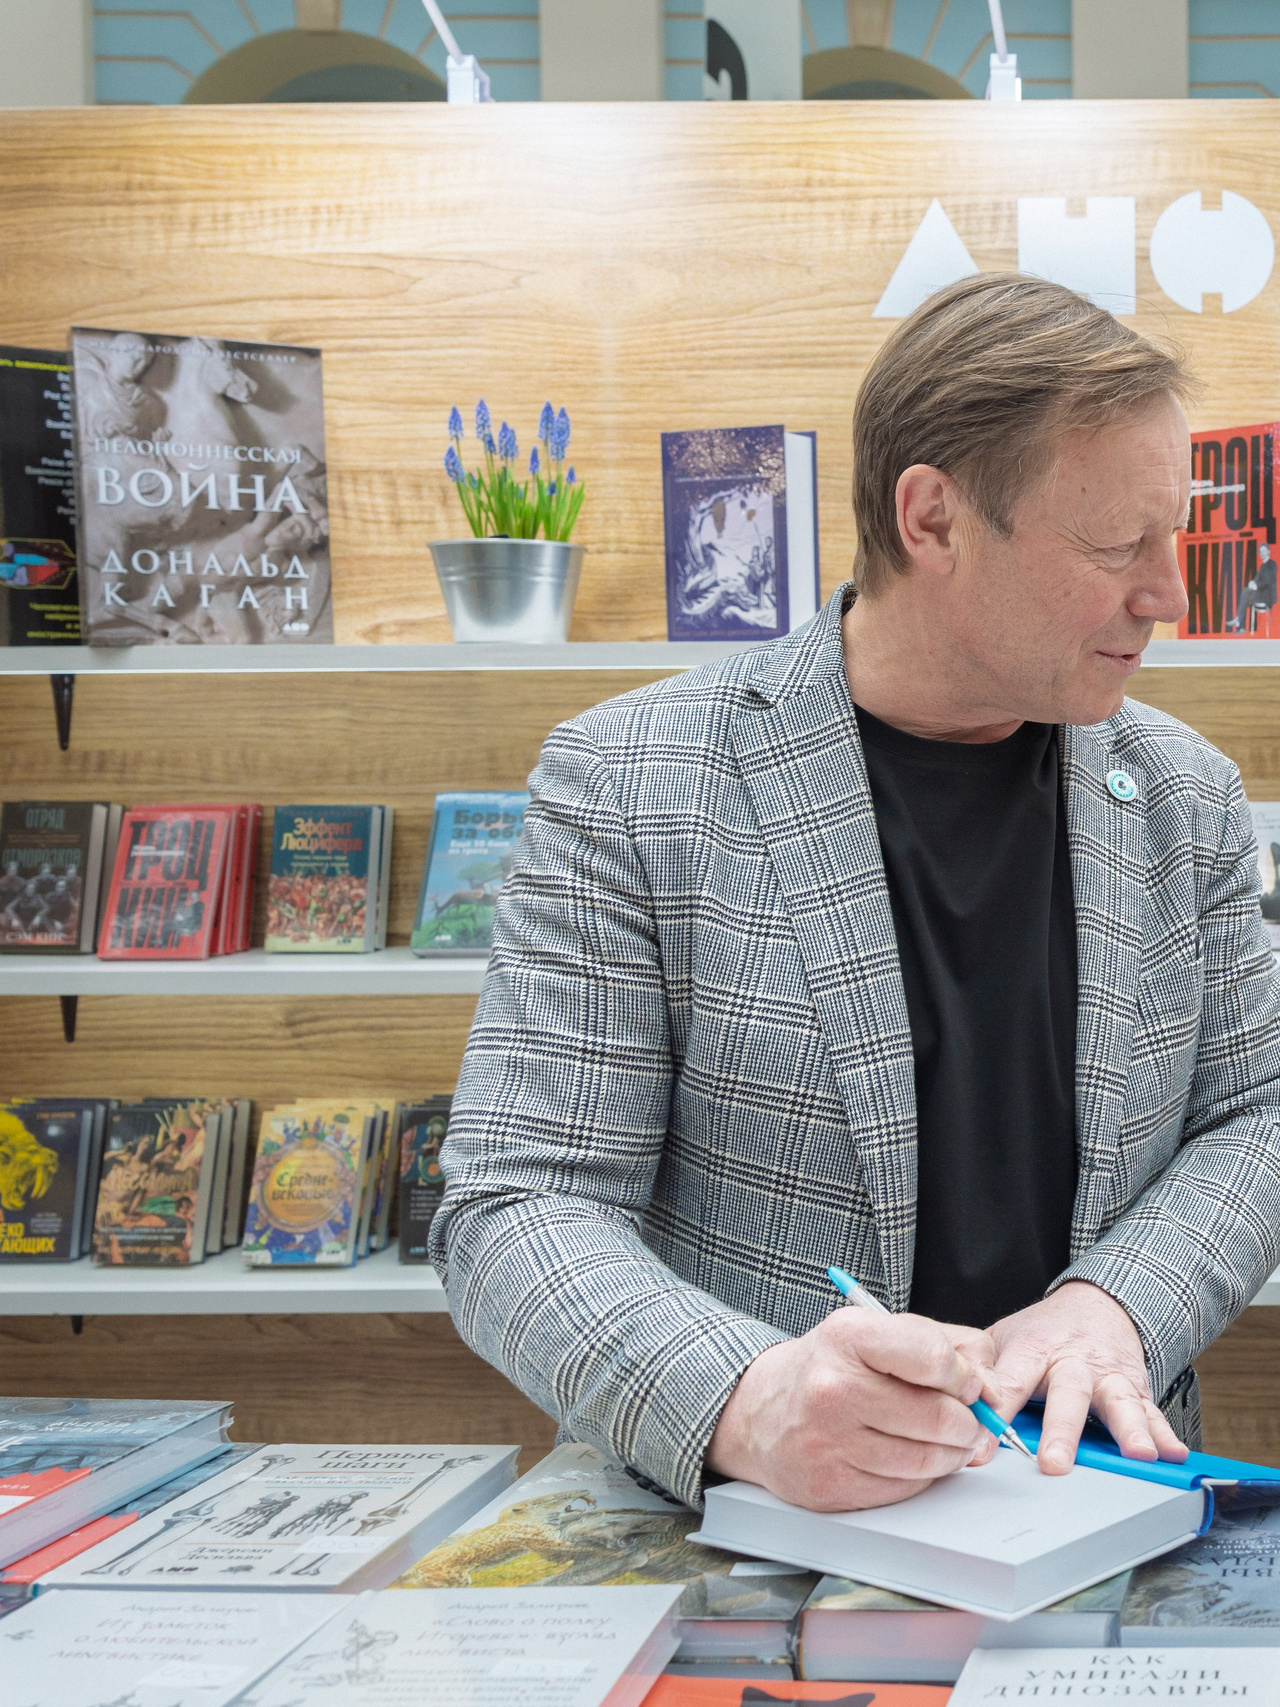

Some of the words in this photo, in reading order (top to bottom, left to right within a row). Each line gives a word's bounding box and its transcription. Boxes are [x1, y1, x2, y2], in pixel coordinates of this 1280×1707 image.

[94, 438, 302, 464] ПЕЛОПОННЕССКАЯ
[97, 462, 308, 514] ВОЙНА
[101, 549, 310, 579] ДОНАЛЬД
[104, 581, 309, 610] КАГАН
[293, 817, 353, 838] Эффект
[280, 832, 363, 853] Люцифера
[315, 1450, 445, 1461] Первые
[320, 1460, 409, 1469] шаги
[1091, 1655, 1166, 1665] КАК
[1024, 1669, 1222, 1680] УМИРАЛИ
